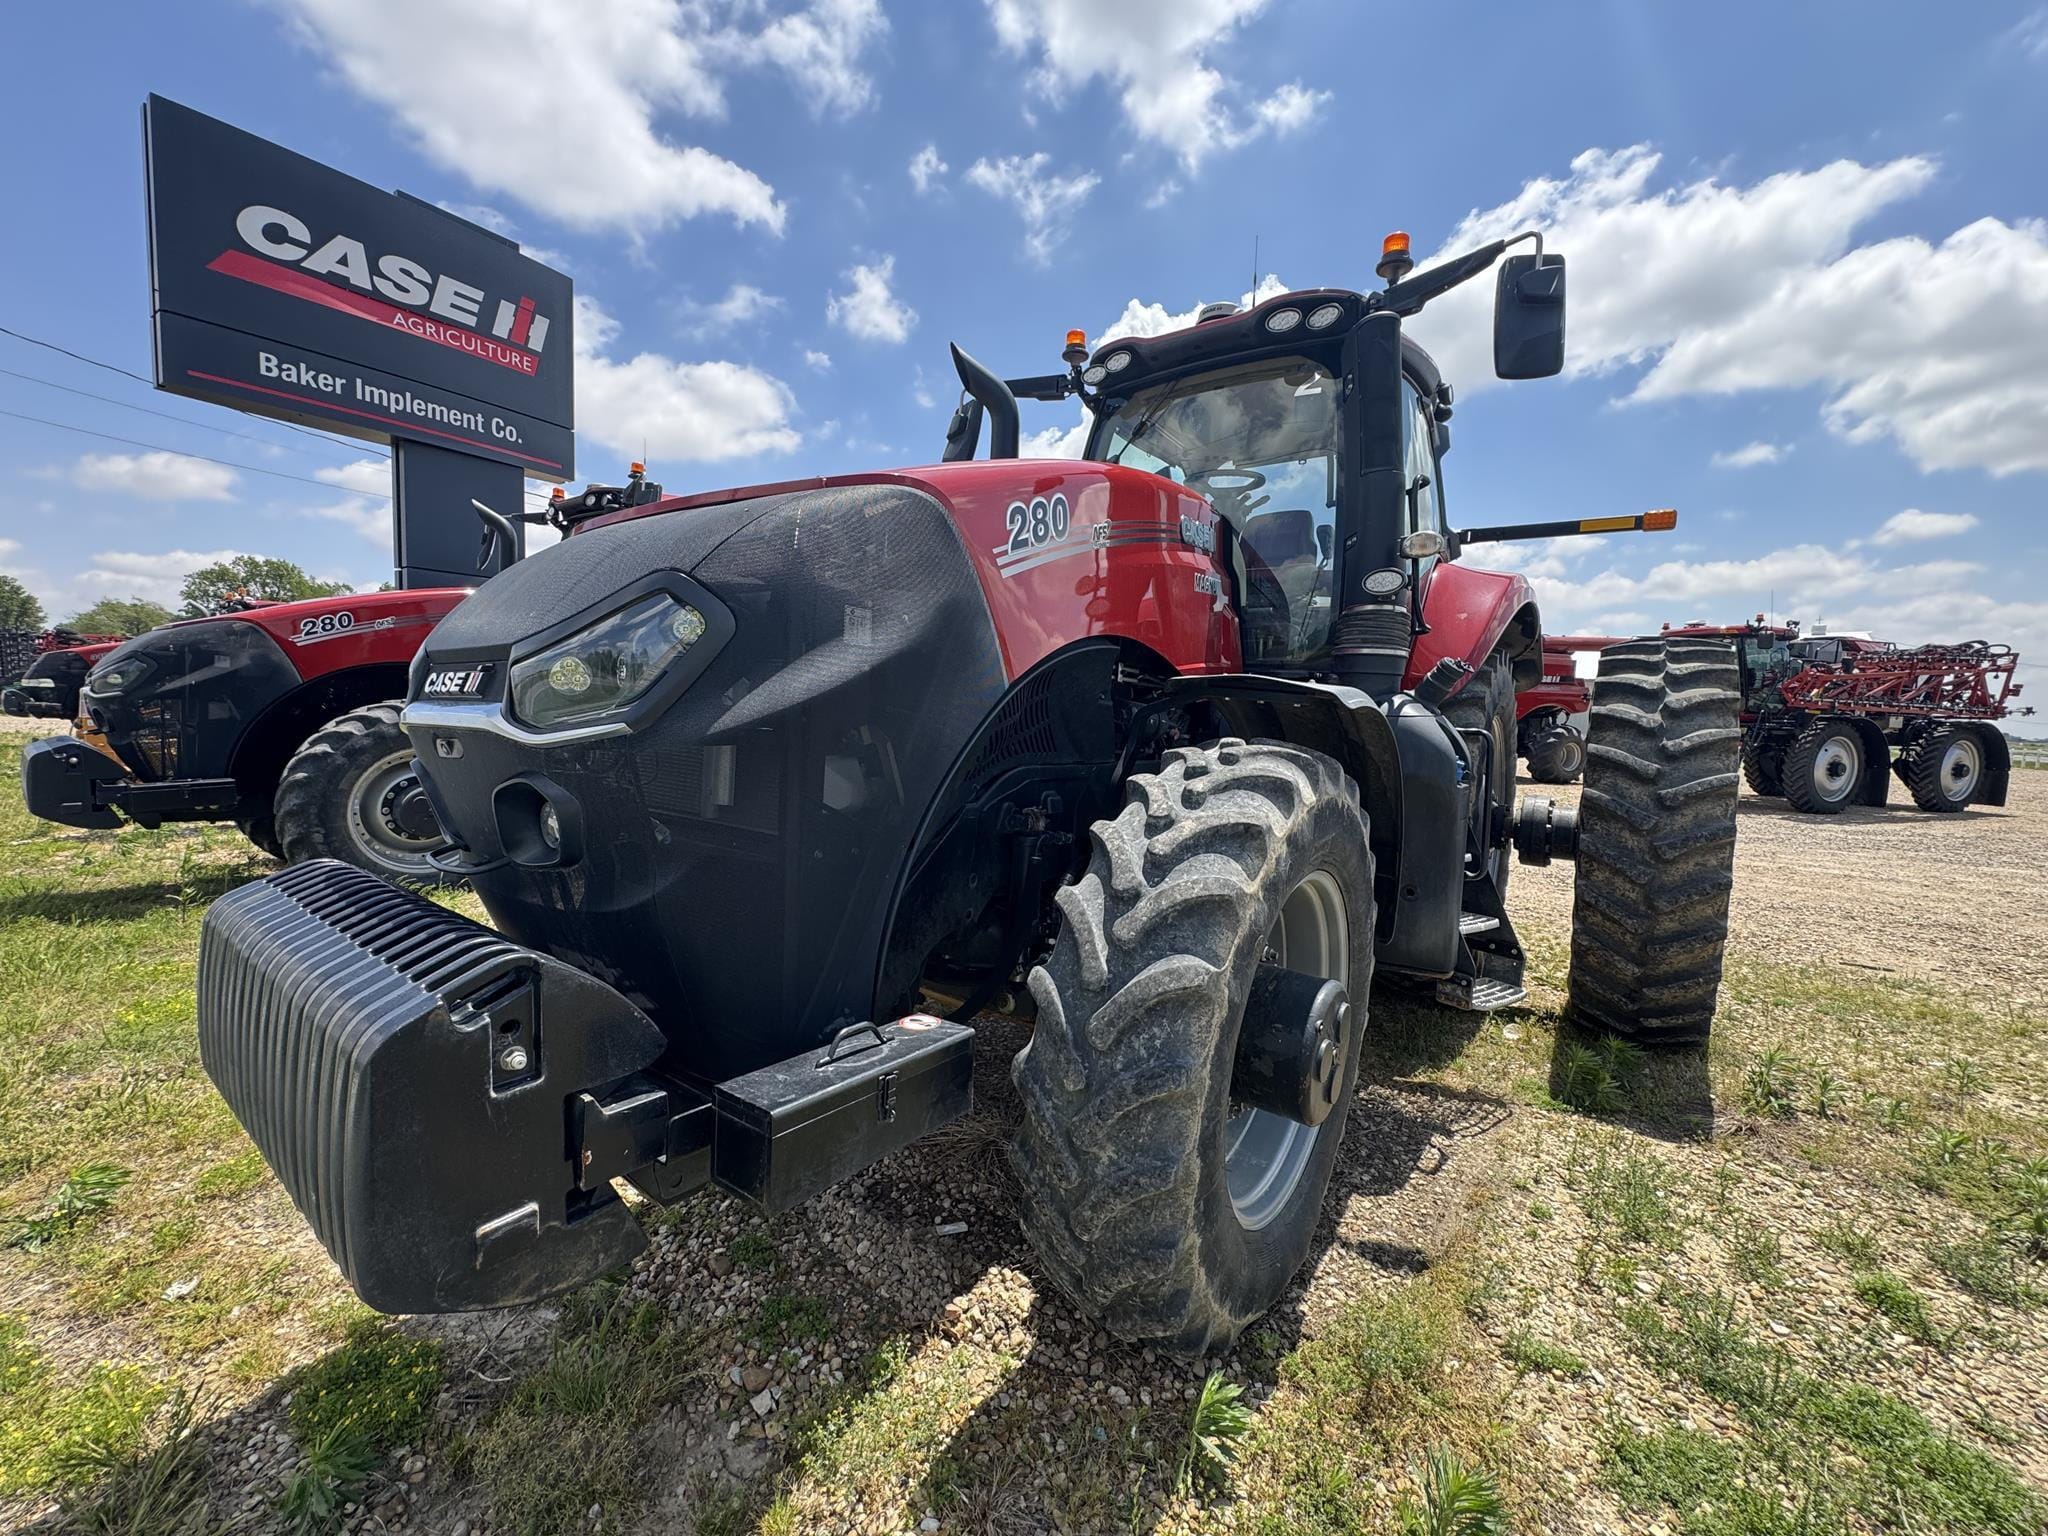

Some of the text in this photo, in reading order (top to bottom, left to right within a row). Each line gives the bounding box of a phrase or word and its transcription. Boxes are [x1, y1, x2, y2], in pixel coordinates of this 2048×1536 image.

[235, 205, 485, 327] CASE
[393, 312, 533, 372] AGRICULTURE
[259, 351, 523, 444] Baker Implement Co.
[1006, 493, 1070, 555] 280
[1193, 571, 1222, 598] MAGNU
[301, 611, 354, 638] 280
[424, 671, 466, 693] CASE
